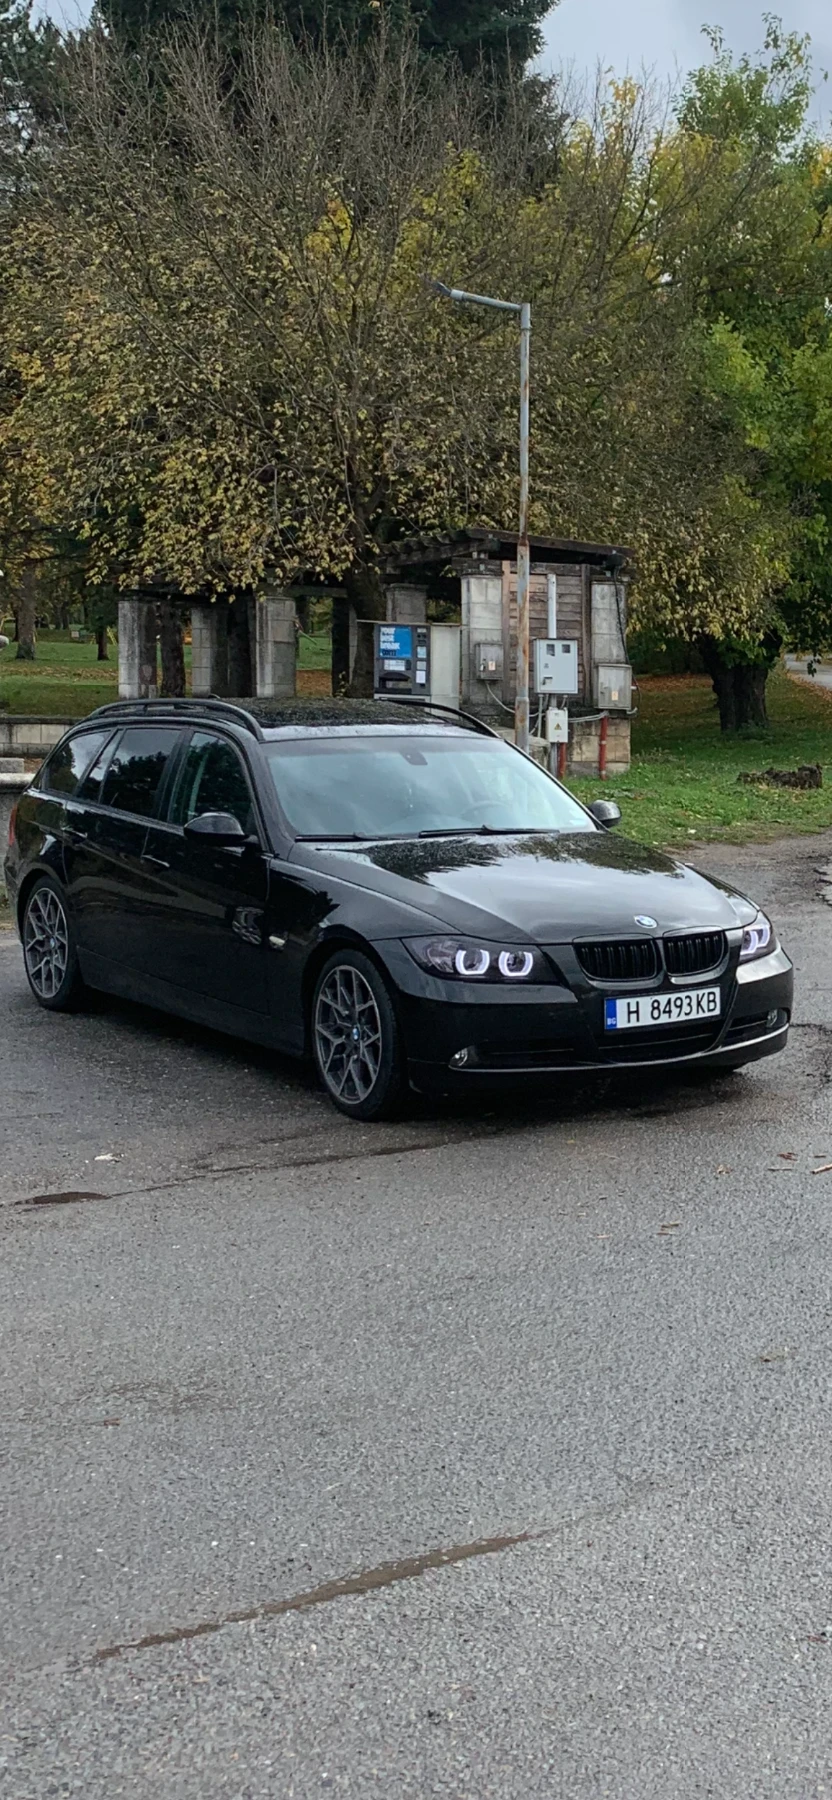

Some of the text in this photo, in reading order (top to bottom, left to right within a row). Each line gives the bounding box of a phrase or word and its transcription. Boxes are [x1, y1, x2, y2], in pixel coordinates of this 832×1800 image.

[627, 991, 717, 1024] H 8493 KB
[607, 1017, 616, 1025] BG
